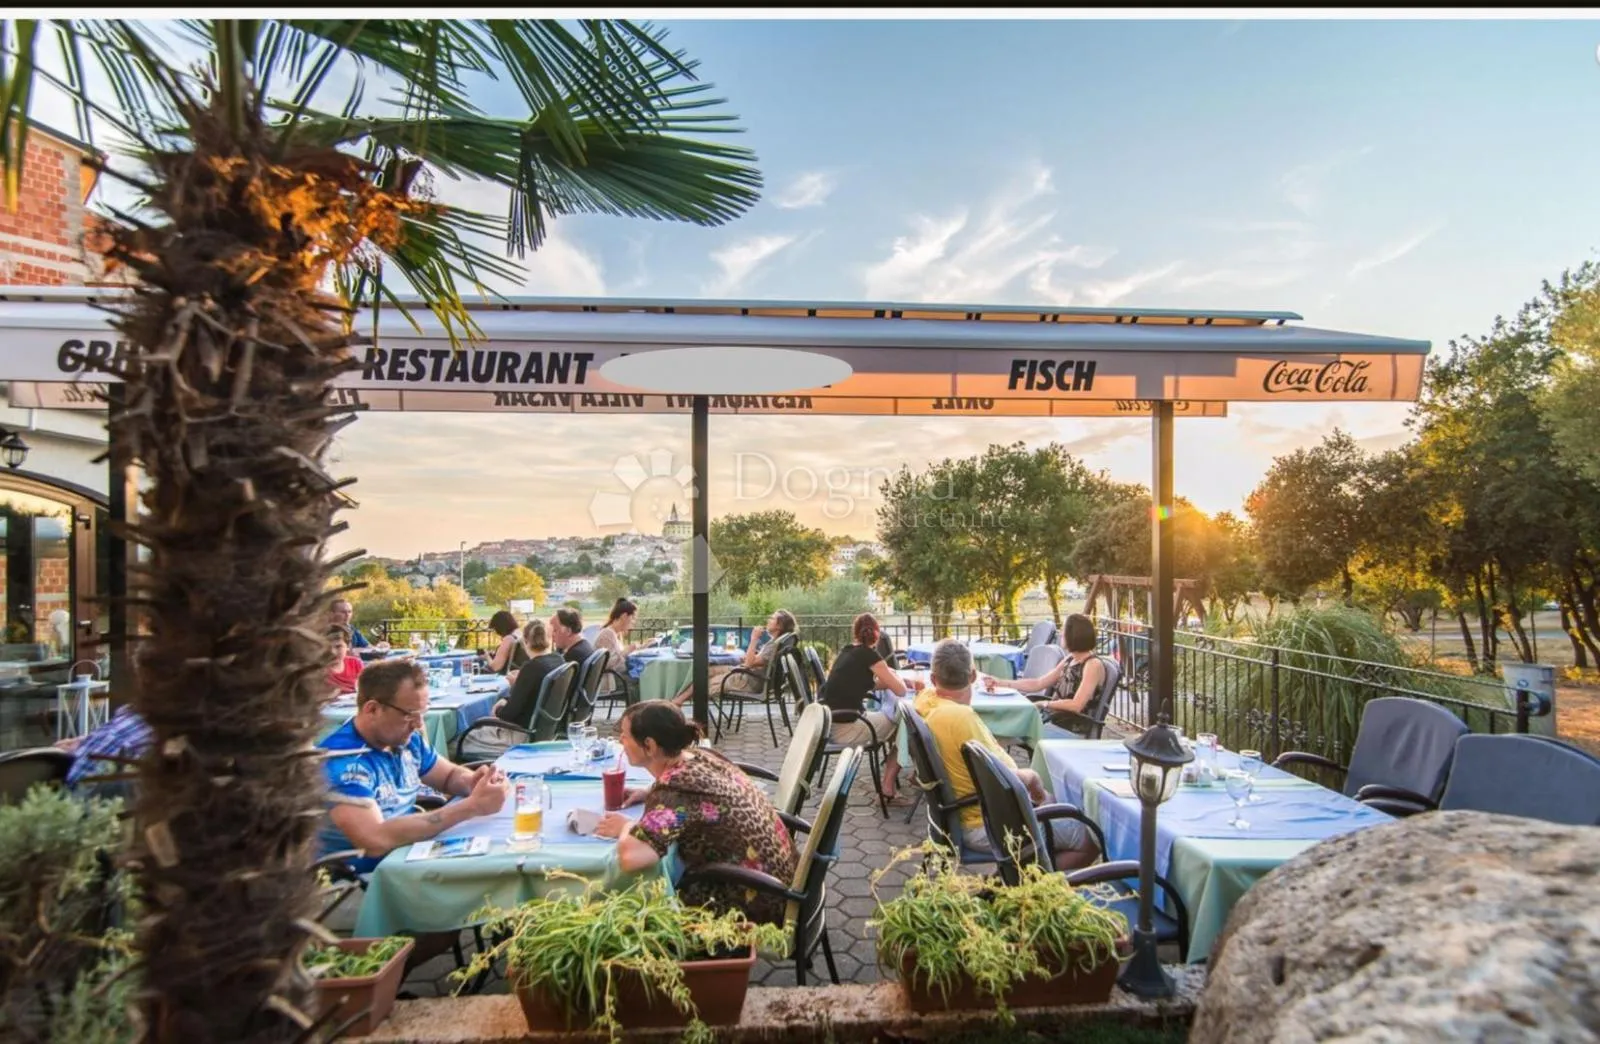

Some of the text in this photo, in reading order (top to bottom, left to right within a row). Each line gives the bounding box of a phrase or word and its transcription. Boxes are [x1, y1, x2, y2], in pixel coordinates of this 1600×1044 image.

[362, 348, 594, 384] RESTAURANT
[1008, 359, 1096, 391] FISCH
[1263, 360, 1372, 393] Coca-Cola
